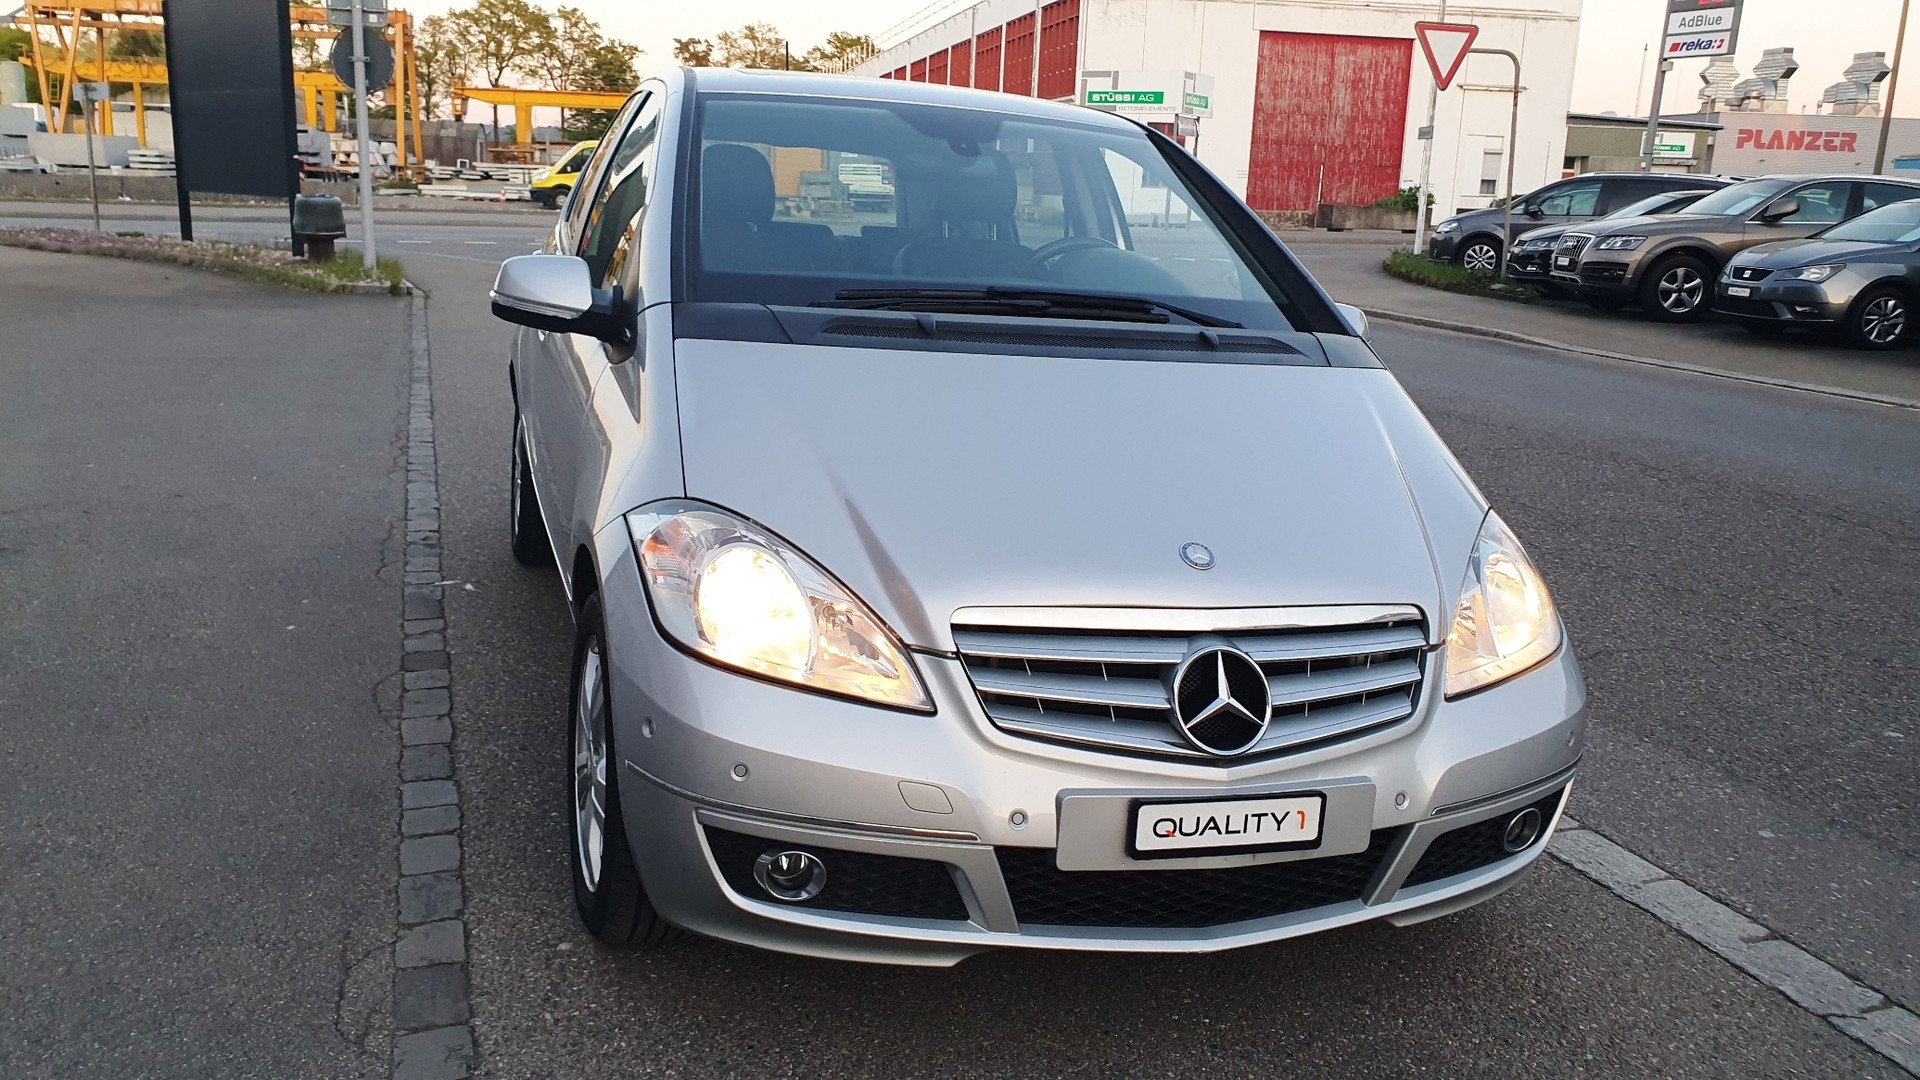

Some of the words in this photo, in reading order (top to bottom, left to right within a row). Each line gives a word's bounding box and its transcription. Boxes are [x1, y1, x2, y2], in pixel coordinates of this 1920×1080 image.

[1678, 15, 1723, 28] AdBlue
[1138, 94, 1155, 102] AG
[1736, 128, 1857, 153] PLANZER
[1153, 811, 1291, 839] QUALITY
[1296, 810, 1306, 830] 1
